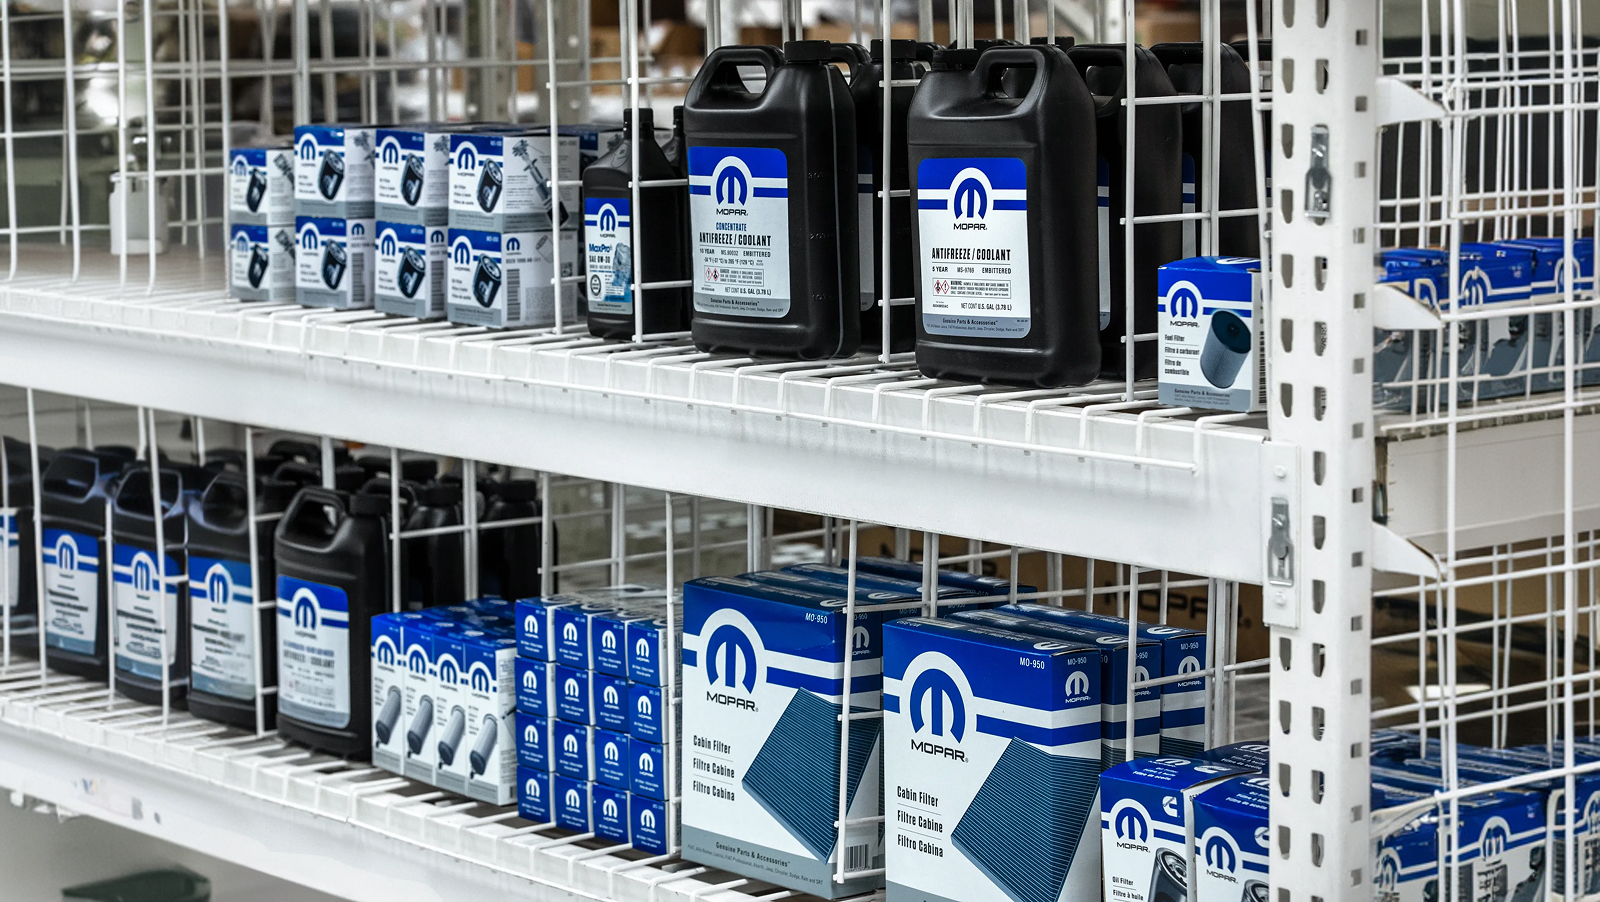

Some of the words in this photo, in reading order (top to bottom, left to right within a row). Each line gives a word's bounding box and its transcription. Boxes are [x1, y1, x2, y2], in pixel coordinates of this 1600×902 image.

[716, 208, 746, 216] MOPAR
[716, 222, 747, 232] CONCENTRATE
[700, 232, 732, 246] ANTIFREEZE
[738, 234, 772, 246] COOLANT
[932, 248, 970, 260] ANTIFREEZE
[976, 248, 1011, 261] COOLANT
[1170, 320, 1198, 328] MOPAR
[1165, 346, 1176, 354] Filtre
[1165, 368, 1189, 376] combustible
[805, 612, 828, 624] MO-950
[1181, 642, 1199, 650] MO-950
[1020, 657, 1045, 669] MO-950
[1068, 656, 1087, 665] MO-950
[707, 691, 755, 712] MOPAR
[1065, 696, 1089, 704] MOPAR
[693, 735, 711, 749] Cabin
[713, 740, 731, 754] Filter
[911, 739, 965, 763] MOPAR
[693, 758, 710, 772] Filtre
[712, 763, 734, 778] Cabine
[693, 780, 710, 795] Filtro
[712, 786, 734, 801] Cabina
[897, 786, 916, 802] Cabin
[920, 792, 938, 807] Filter
[897, 810, 916, 825] Filtre
[919, 816, 943, 833] Cabine
[897, 834, 916, 850] Filtro
[919, 840, 943, 858] Cabina
[1116, 842, 1148, 852] MOPAR
[716, 841, 735, 853] Genuine
[737, 847, 750, 857] Parts
[757, 852, 788, 867] Accessories
[1120, 878, 1133, 886] Filter
[1206, 869, 1237, 884] MOPAR
[1113, 890, 1126, 898] Filtre
[1132, 893, 1144, 901] huile
